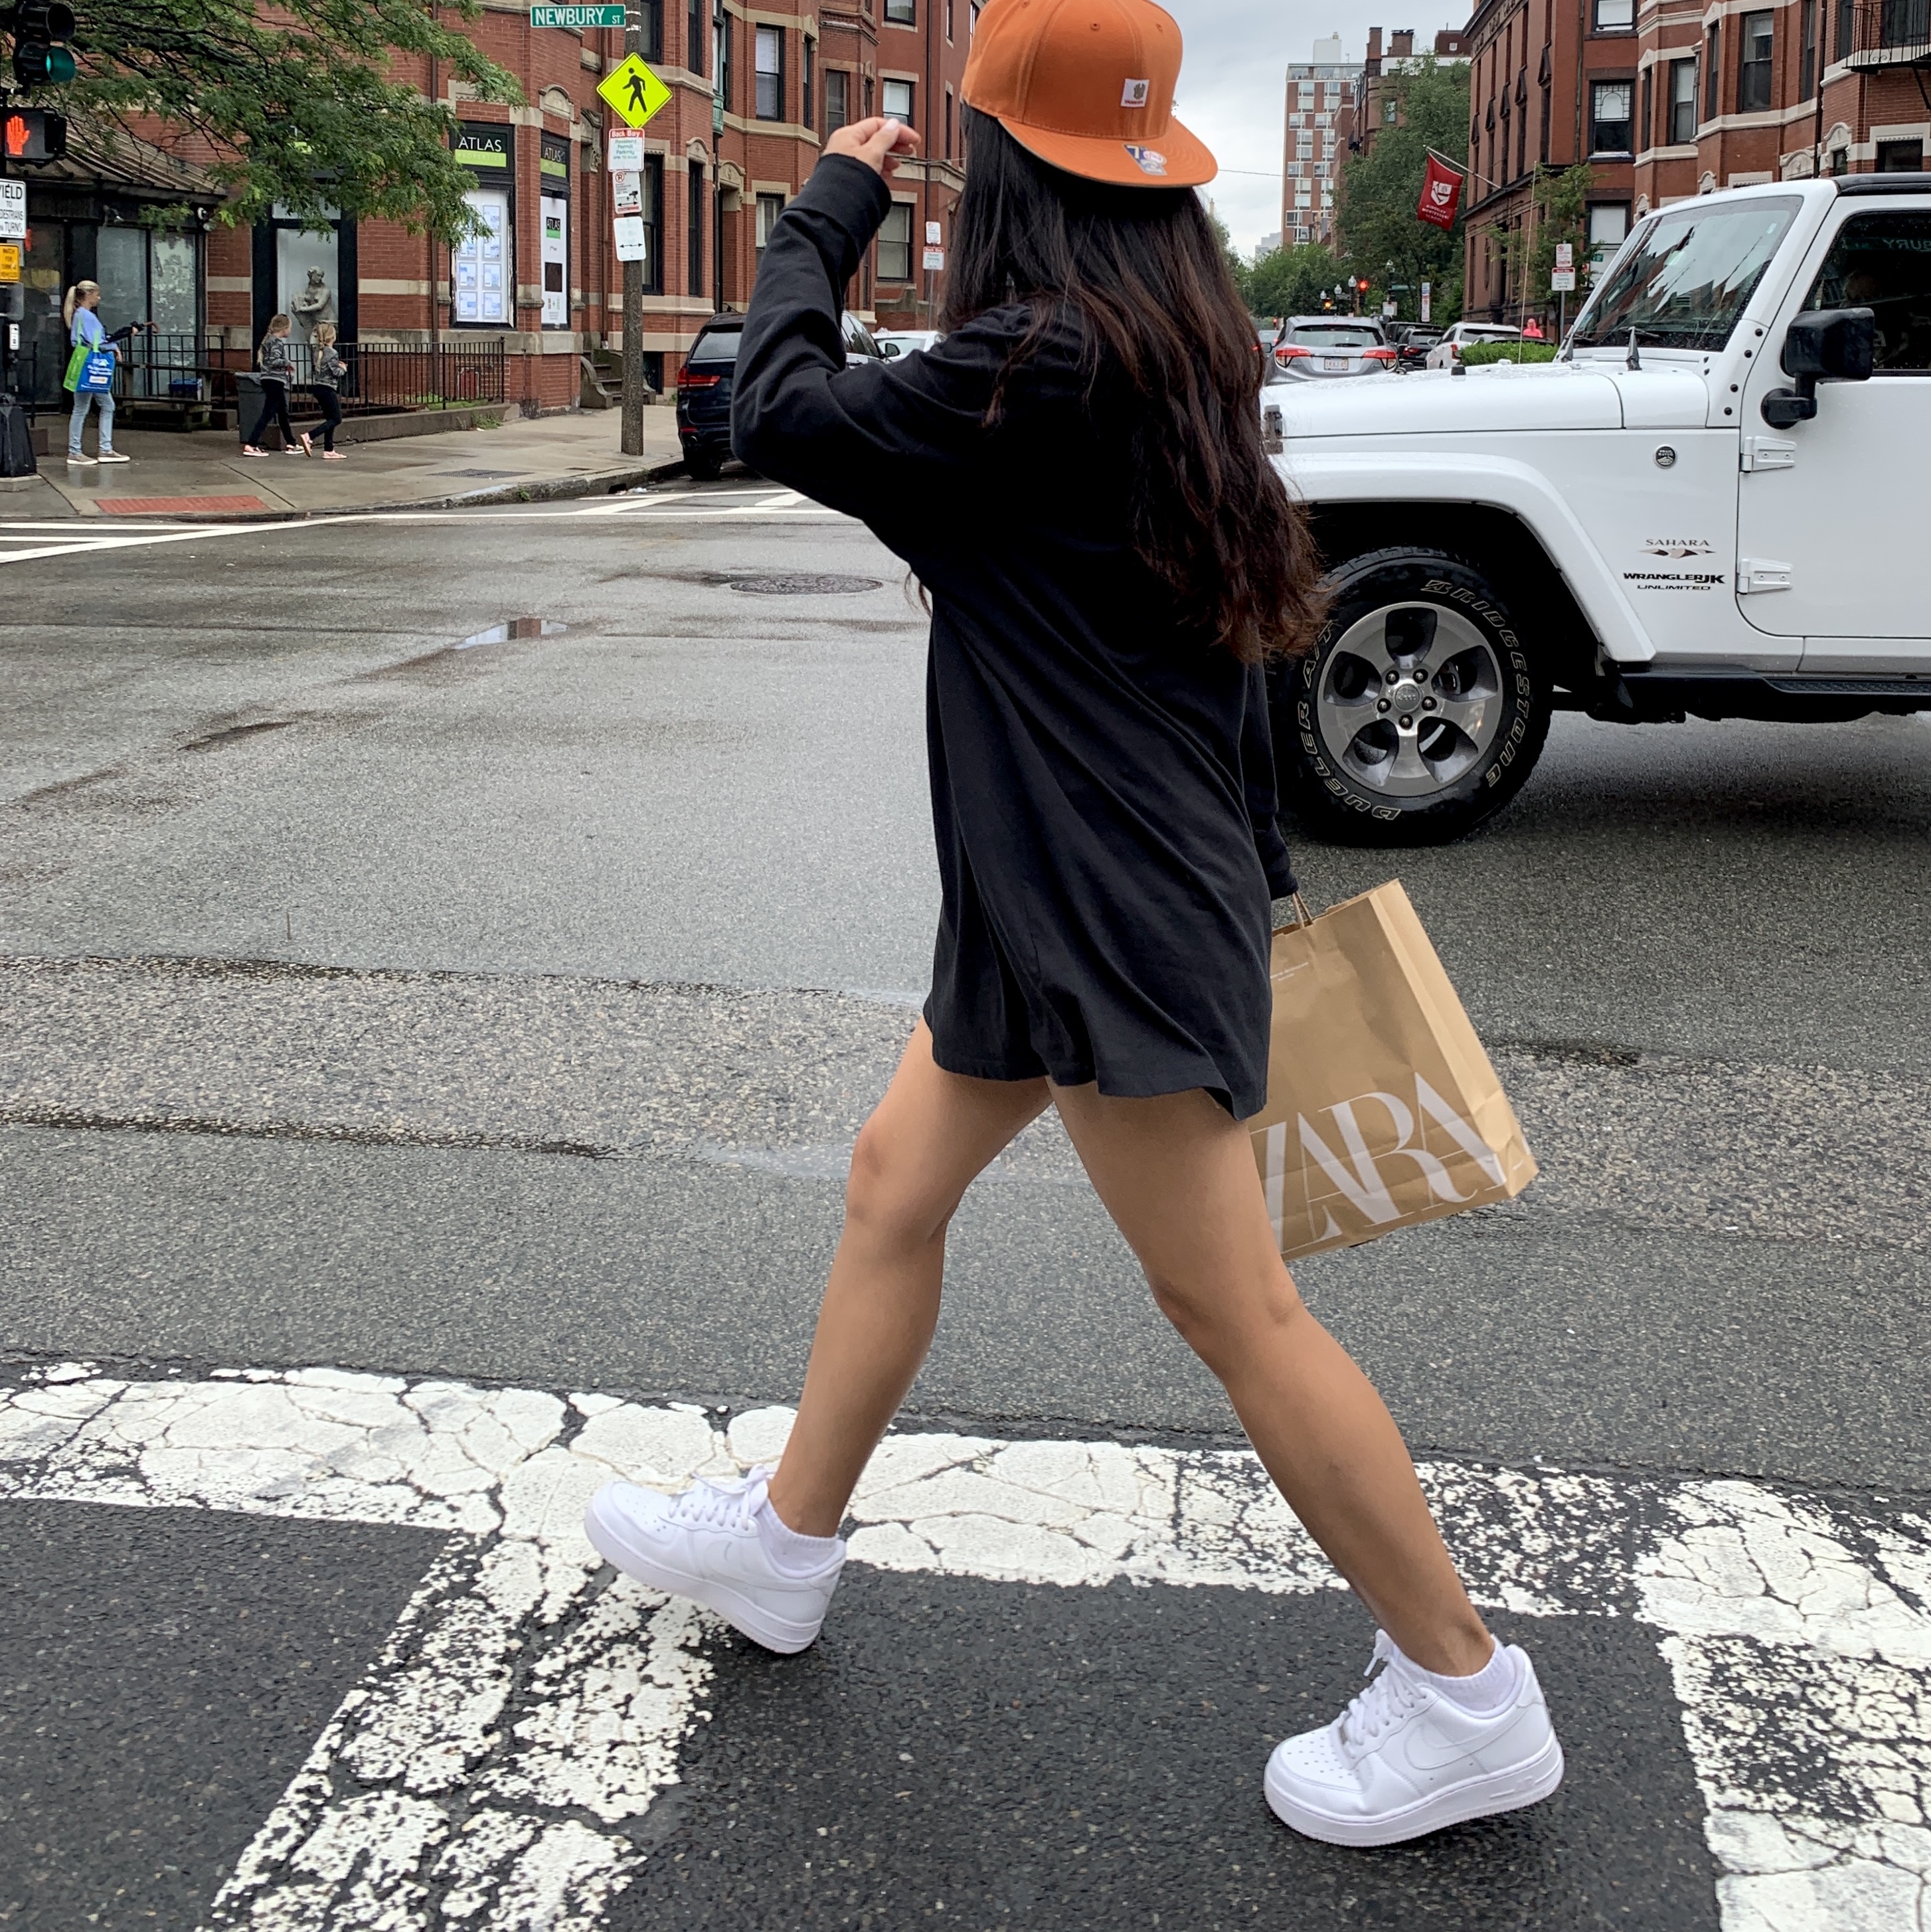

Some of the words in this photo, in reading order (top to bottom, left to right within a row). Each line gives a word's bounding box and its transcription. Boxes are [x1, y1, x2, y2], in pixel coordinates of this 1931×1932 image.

[535, 7, 605, 25] NEWBURY
[612, 15, 621, 24] ST
[458, 136, 502, 152] ATLAS
[458, 152, 502, 161] PROPERTIES
[544, 147, 562, 162] ATLAS
[546, 219, 560, 230] ATLAS
[1420, 579, 1529, 788] BRIDGESTONE
[1298, 701, 1401, 821] DUELER
